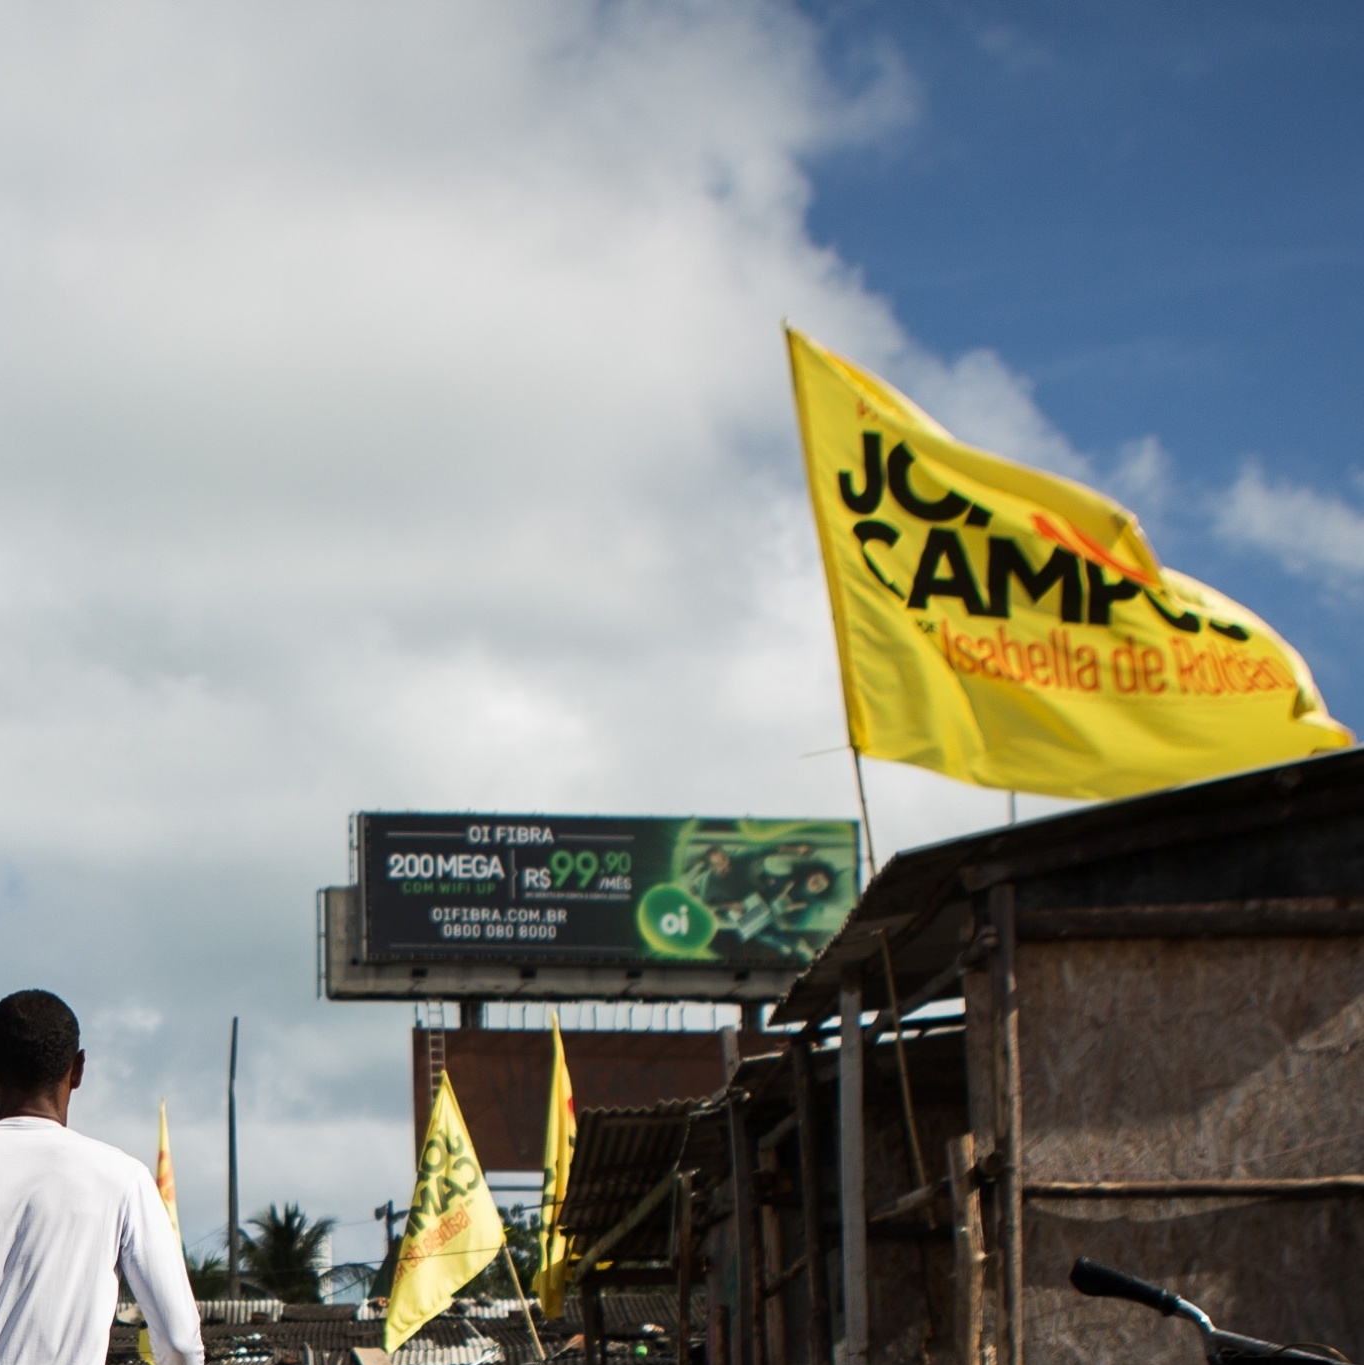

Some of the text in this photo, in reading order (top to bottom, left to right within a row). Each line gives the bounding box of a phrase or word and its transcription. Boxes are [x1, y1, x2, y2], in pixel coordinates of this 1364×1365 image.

[852, 519, 1251, 642] CAMP
[939, 618, 1100, 693] Isabella
[1111, 635, 1167, 694] de
[468, 825, 555, 844] OI FIBRA
[388, 853, 434, 879] 200
[437, 854, 506, 880] MEGA
[524, 866, 551, 889] R$
[401, 881, 497, 894] COM WIFI UP
[432, 907, 568, 924] OIFIBRA.COM.BR
[660, 904, 689, 935] oi
[443, 924, 557, 939] 0800 080 8000
